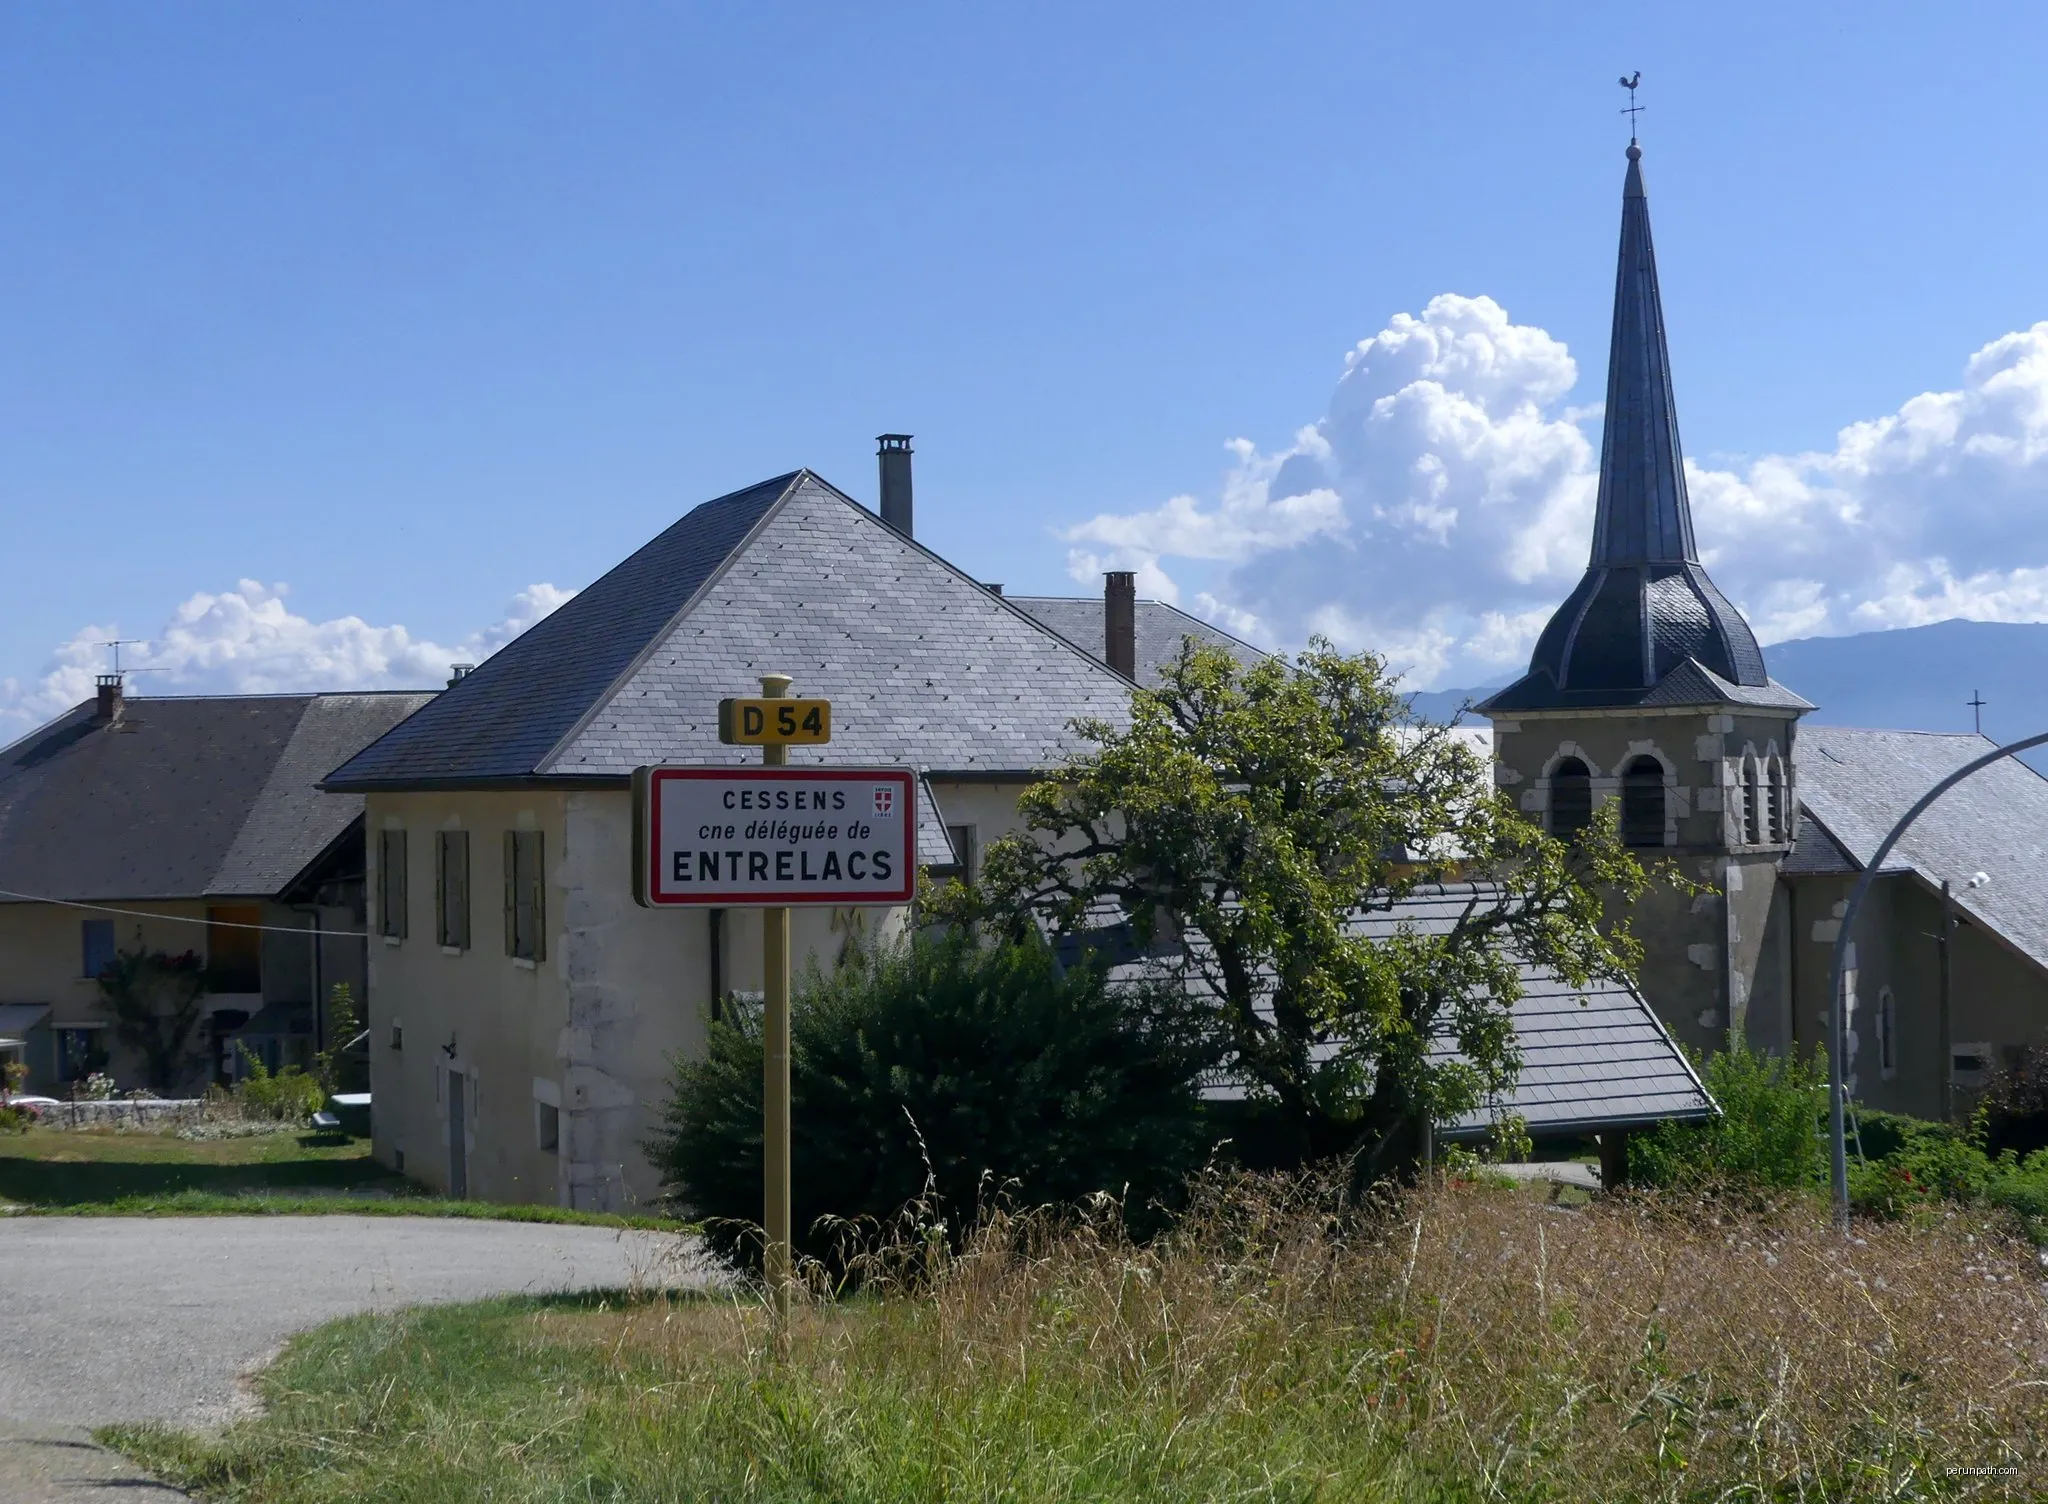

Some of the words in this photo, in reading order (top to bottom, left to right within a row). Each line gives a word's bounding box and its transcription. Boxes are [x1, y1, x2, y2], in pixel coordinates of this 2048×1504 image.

[743, 706, 764, 736] D
[777, 706, 822, 736] 54
[723, 790, 846, 810] CESSENS
[699, 824, 735, 840] cne
[745, 820, 838, 845] déléguée
[847, 820, 871, 840] de
[673, 850, 892, 882] ENTRELACS
